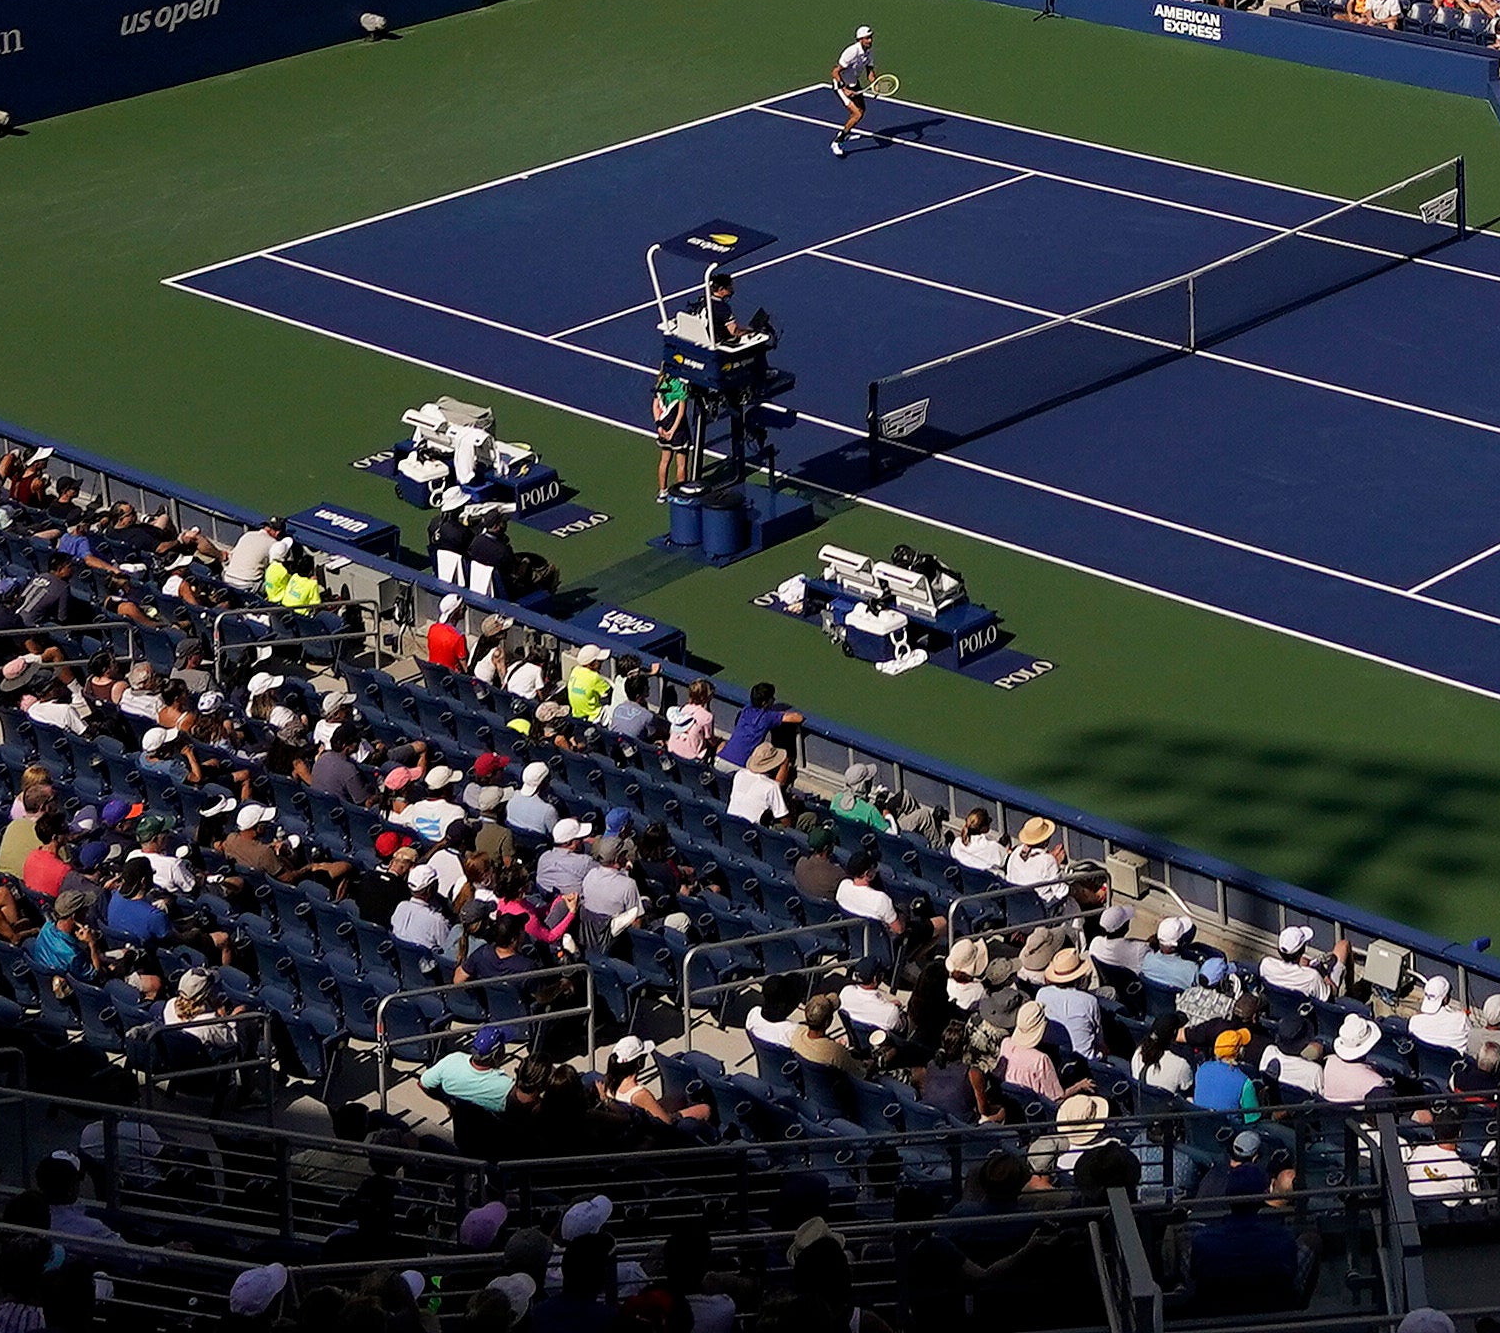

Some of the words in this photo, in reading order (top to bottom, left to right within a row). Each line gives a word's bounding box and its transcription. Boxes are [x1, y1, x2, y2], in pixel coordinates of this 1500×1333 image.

[120, 10, 153, 37] us
[1153, 4, 1221, 27] AMERICAN
[1163, 19, 1222, 41] EXPRESS
[352, 450, 395, 469] OLO
[520, 481, 560, 511] POLO
[550, 513, 610, 539] POLO
[959, 624, 997, 659] POLO
[993, 660, 1054, 690] POLO
